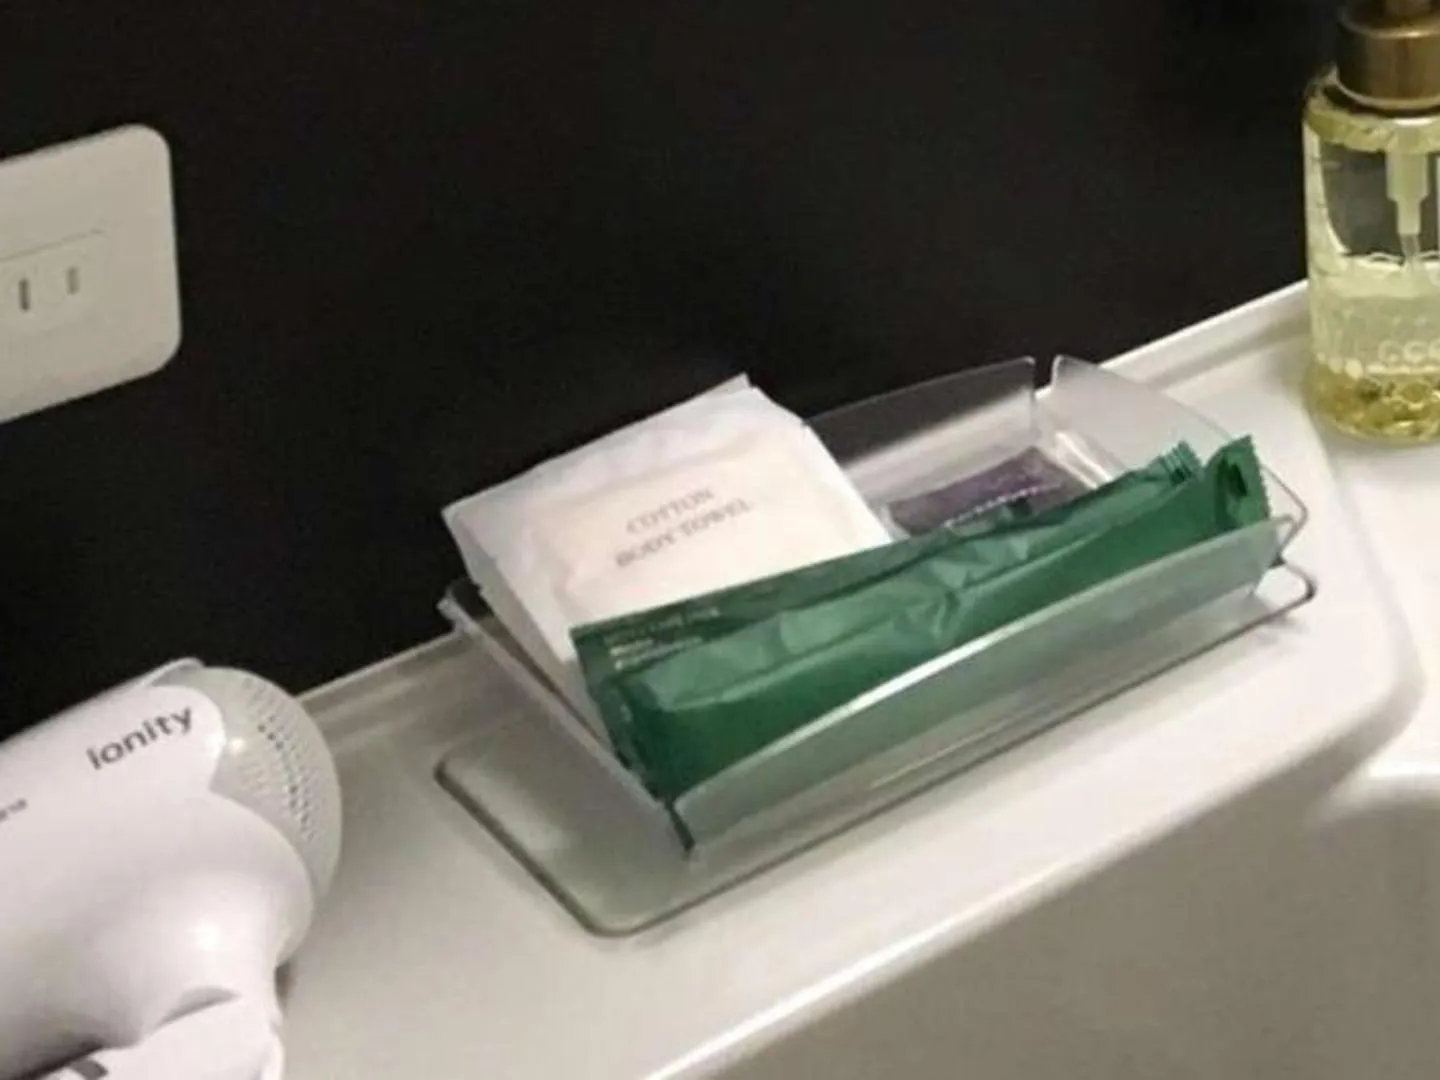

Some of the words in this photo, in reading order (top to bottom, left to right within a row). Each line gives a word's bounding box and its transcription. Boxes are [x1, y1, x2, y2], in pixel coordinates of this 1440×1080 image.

[615, 527, 677, 568] BODY
[680, 498, 754, 536] TOWEL
[626, 488, 716, 534] COTTON
